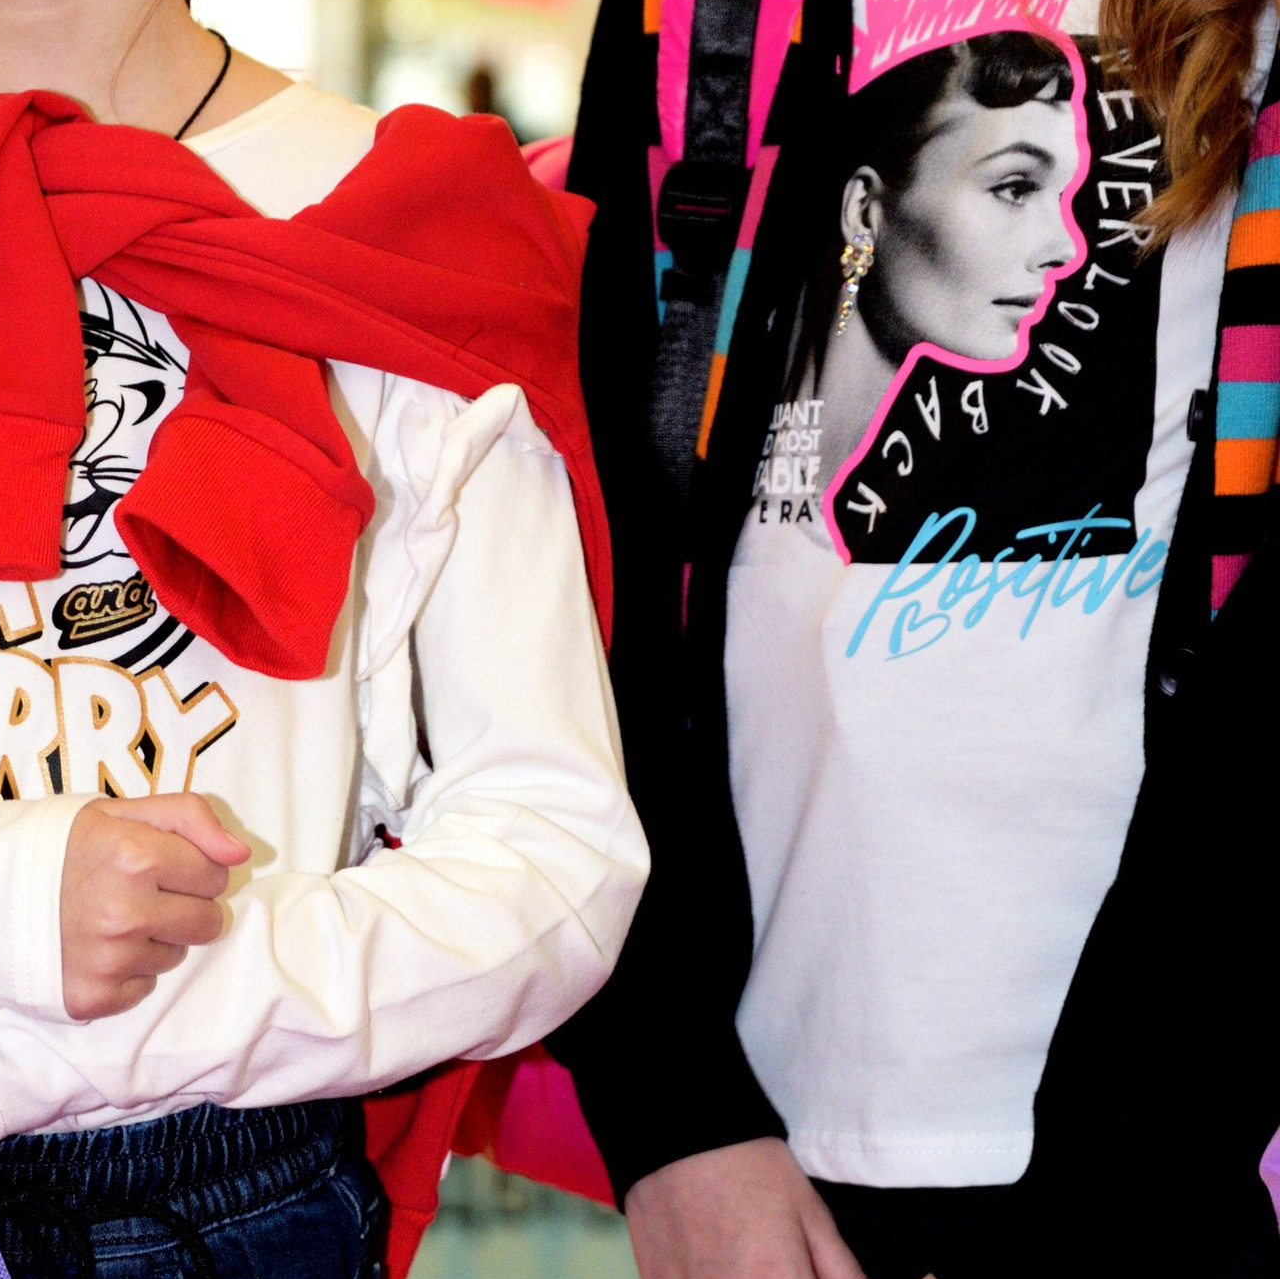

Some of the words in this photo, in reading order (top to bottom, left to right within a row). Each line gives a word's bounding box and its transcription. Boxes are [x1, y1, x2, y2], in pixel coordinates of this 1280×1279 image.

[1016, 263, 1131, 416] LOOK
[847, 376, 989, 534] BACK
[58, 570, 156, 630] and
[846, 503, 1169, 658] Positive
